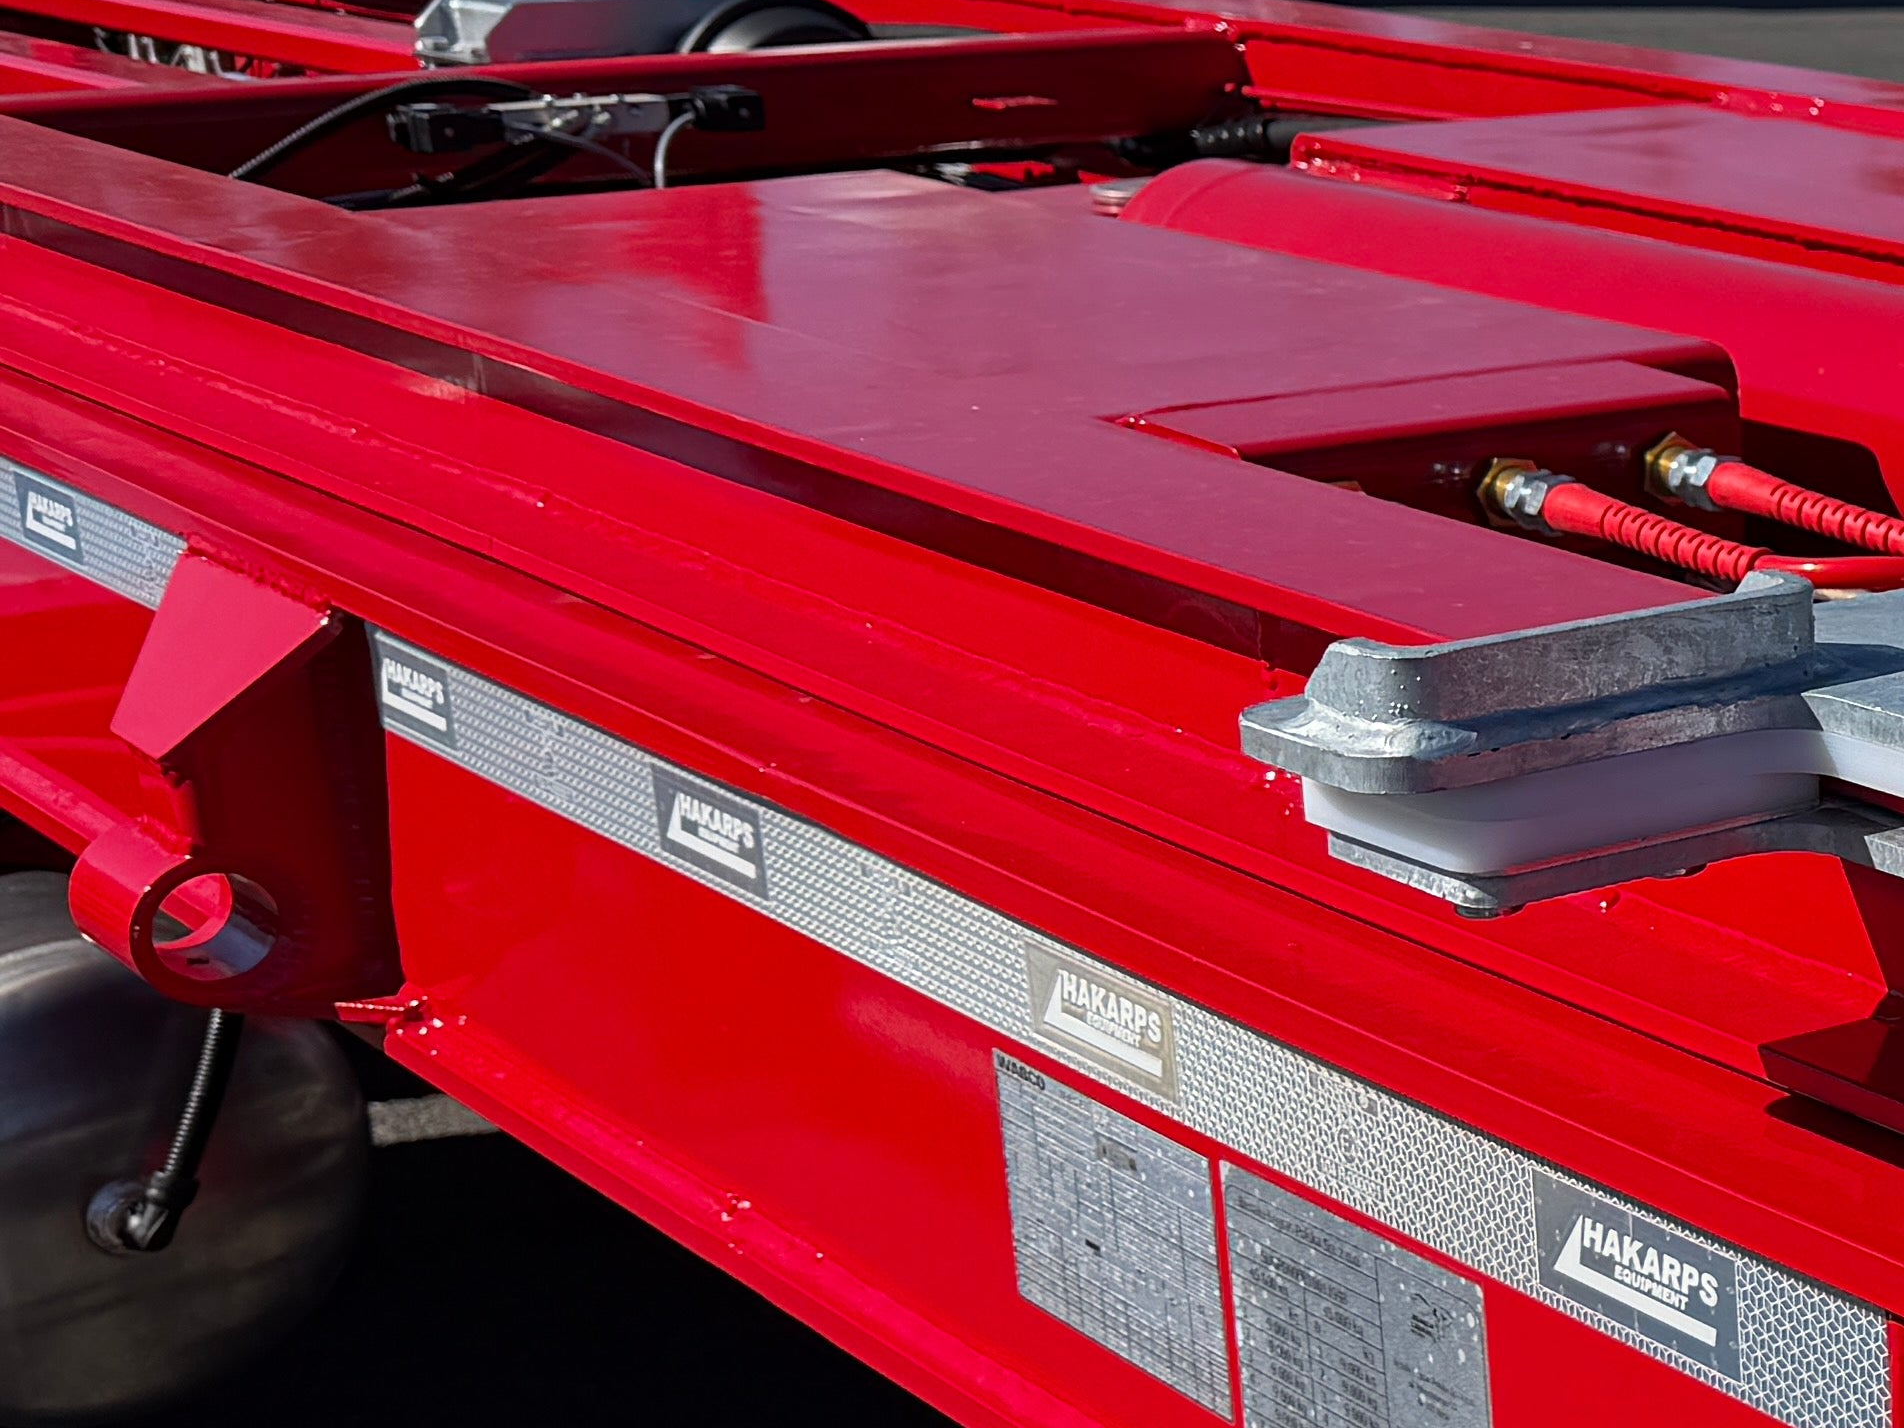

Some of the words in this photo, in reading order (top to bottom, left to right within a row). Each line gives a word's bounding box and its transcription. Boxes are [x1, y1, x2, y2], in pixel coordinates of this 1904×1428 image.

[680, 793, 755, 849] HAKARPS
[1060, 969, 1162, 1043] HAKARPS
[1583, 1217, 1719, 1307] HAKARPS
[1613, 1264, 1689, 1311] EQUIPMENT
